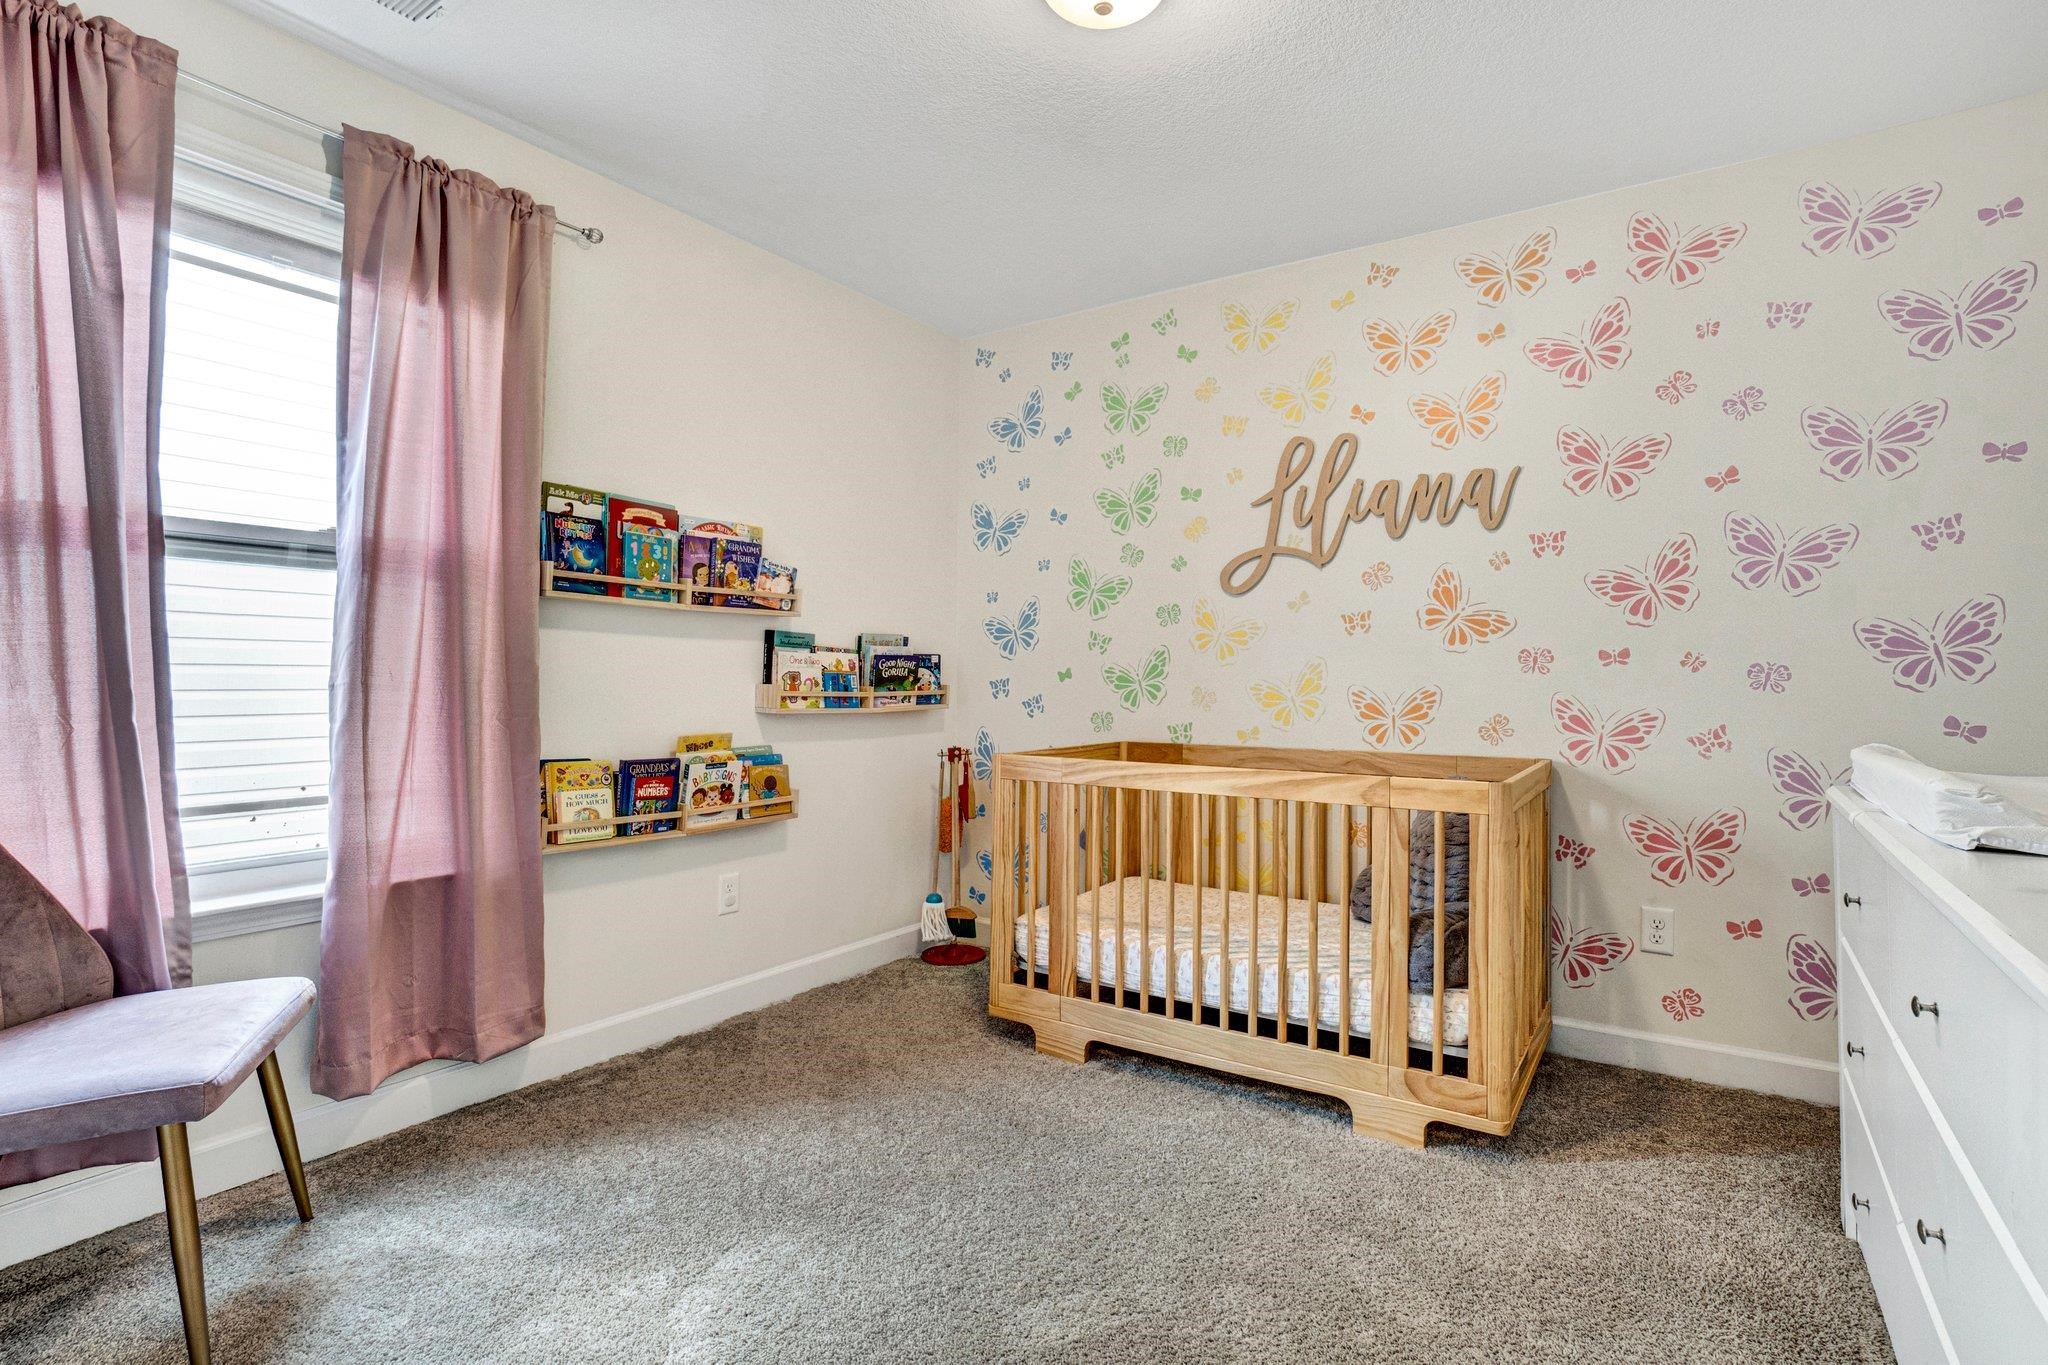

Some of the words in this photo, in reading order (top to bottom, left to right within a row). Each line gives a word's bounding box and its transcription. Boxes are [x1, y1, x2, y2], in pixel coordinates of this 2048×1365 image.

[1219, 432, 1524, 596] Liliana
[732, 553, 756, 564] WISHES
[879, 658, 897, 670] GOOD
[881, 667, 909, 678] GORILLA
[574, 792, 599, 800] GUESS
[637, 786, 669, 798] NUMBERS
[586, 798, 608, 806] MUCH
